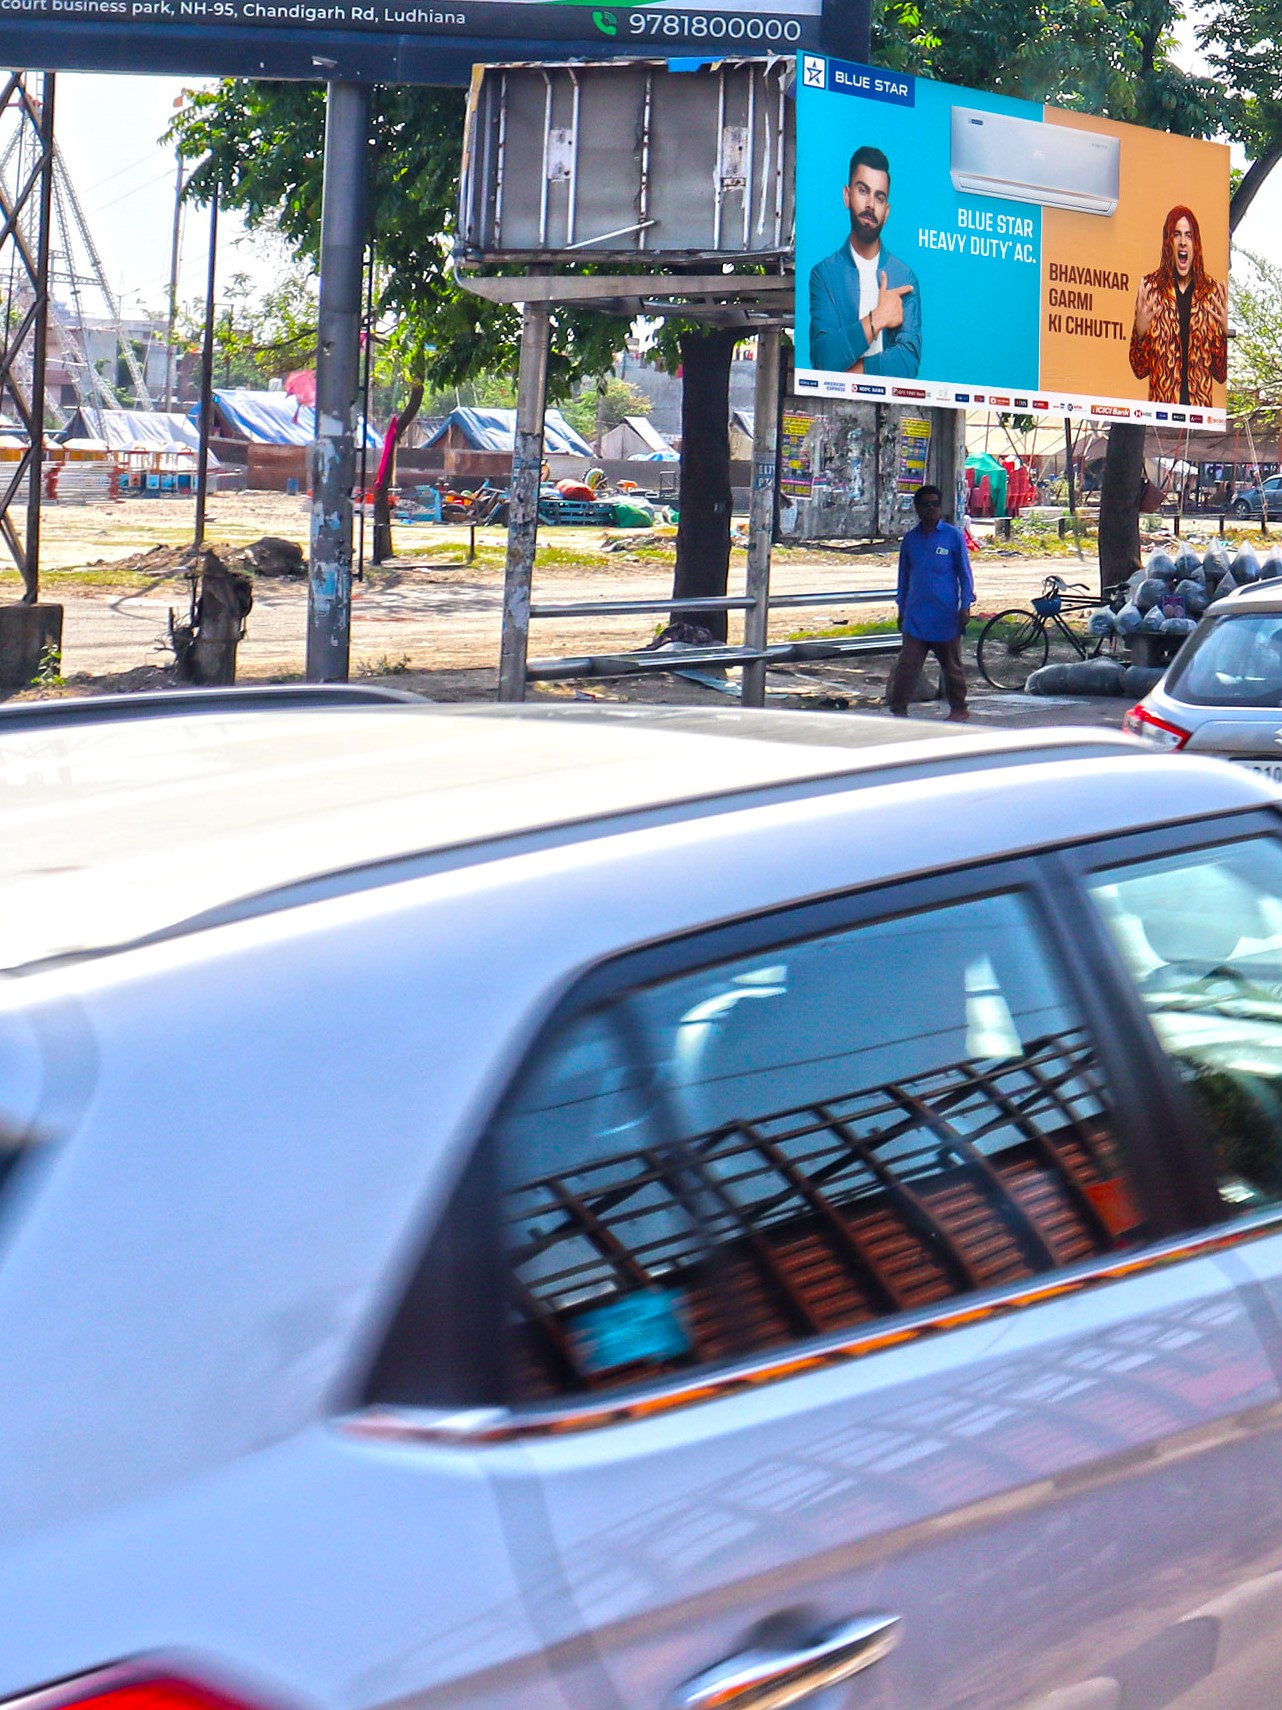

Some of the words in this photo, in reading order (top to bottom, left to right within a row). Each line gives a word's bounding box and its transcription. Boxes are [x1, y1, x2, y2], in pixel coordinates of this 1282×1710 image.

[1, 0, 47, 11] court
[52, 0, 127, 13] business
[132, 2, 175, 16] park,
[180, 3, 238, 18] NH-95,
[243, 3, 345, 21] Chandigarh
[351, 7, 379, 23] Rd,
[384, 8, 466, 24] Ludhiana
[629, 13, 801, 41] 9781800000
[835, 70, 871, 89] BLUE
[874, 79, 908, 97] STAR
[957, 207, 994, 232] BLUE
[997, 214, 1034, 238] STAR
[918, 228, 967, 253] HEAVY
[1013, 243, 1037, 264] AC.
[1049, 262, 1130, 292] BHAYANKAR
[1048, 288, 1093, 312] GARMI
[1048, 313, 1062, 333] KI
[1065, 315, 1127, 341] CHHUTTI.
[1112, 408, 1130, 417] Bank
